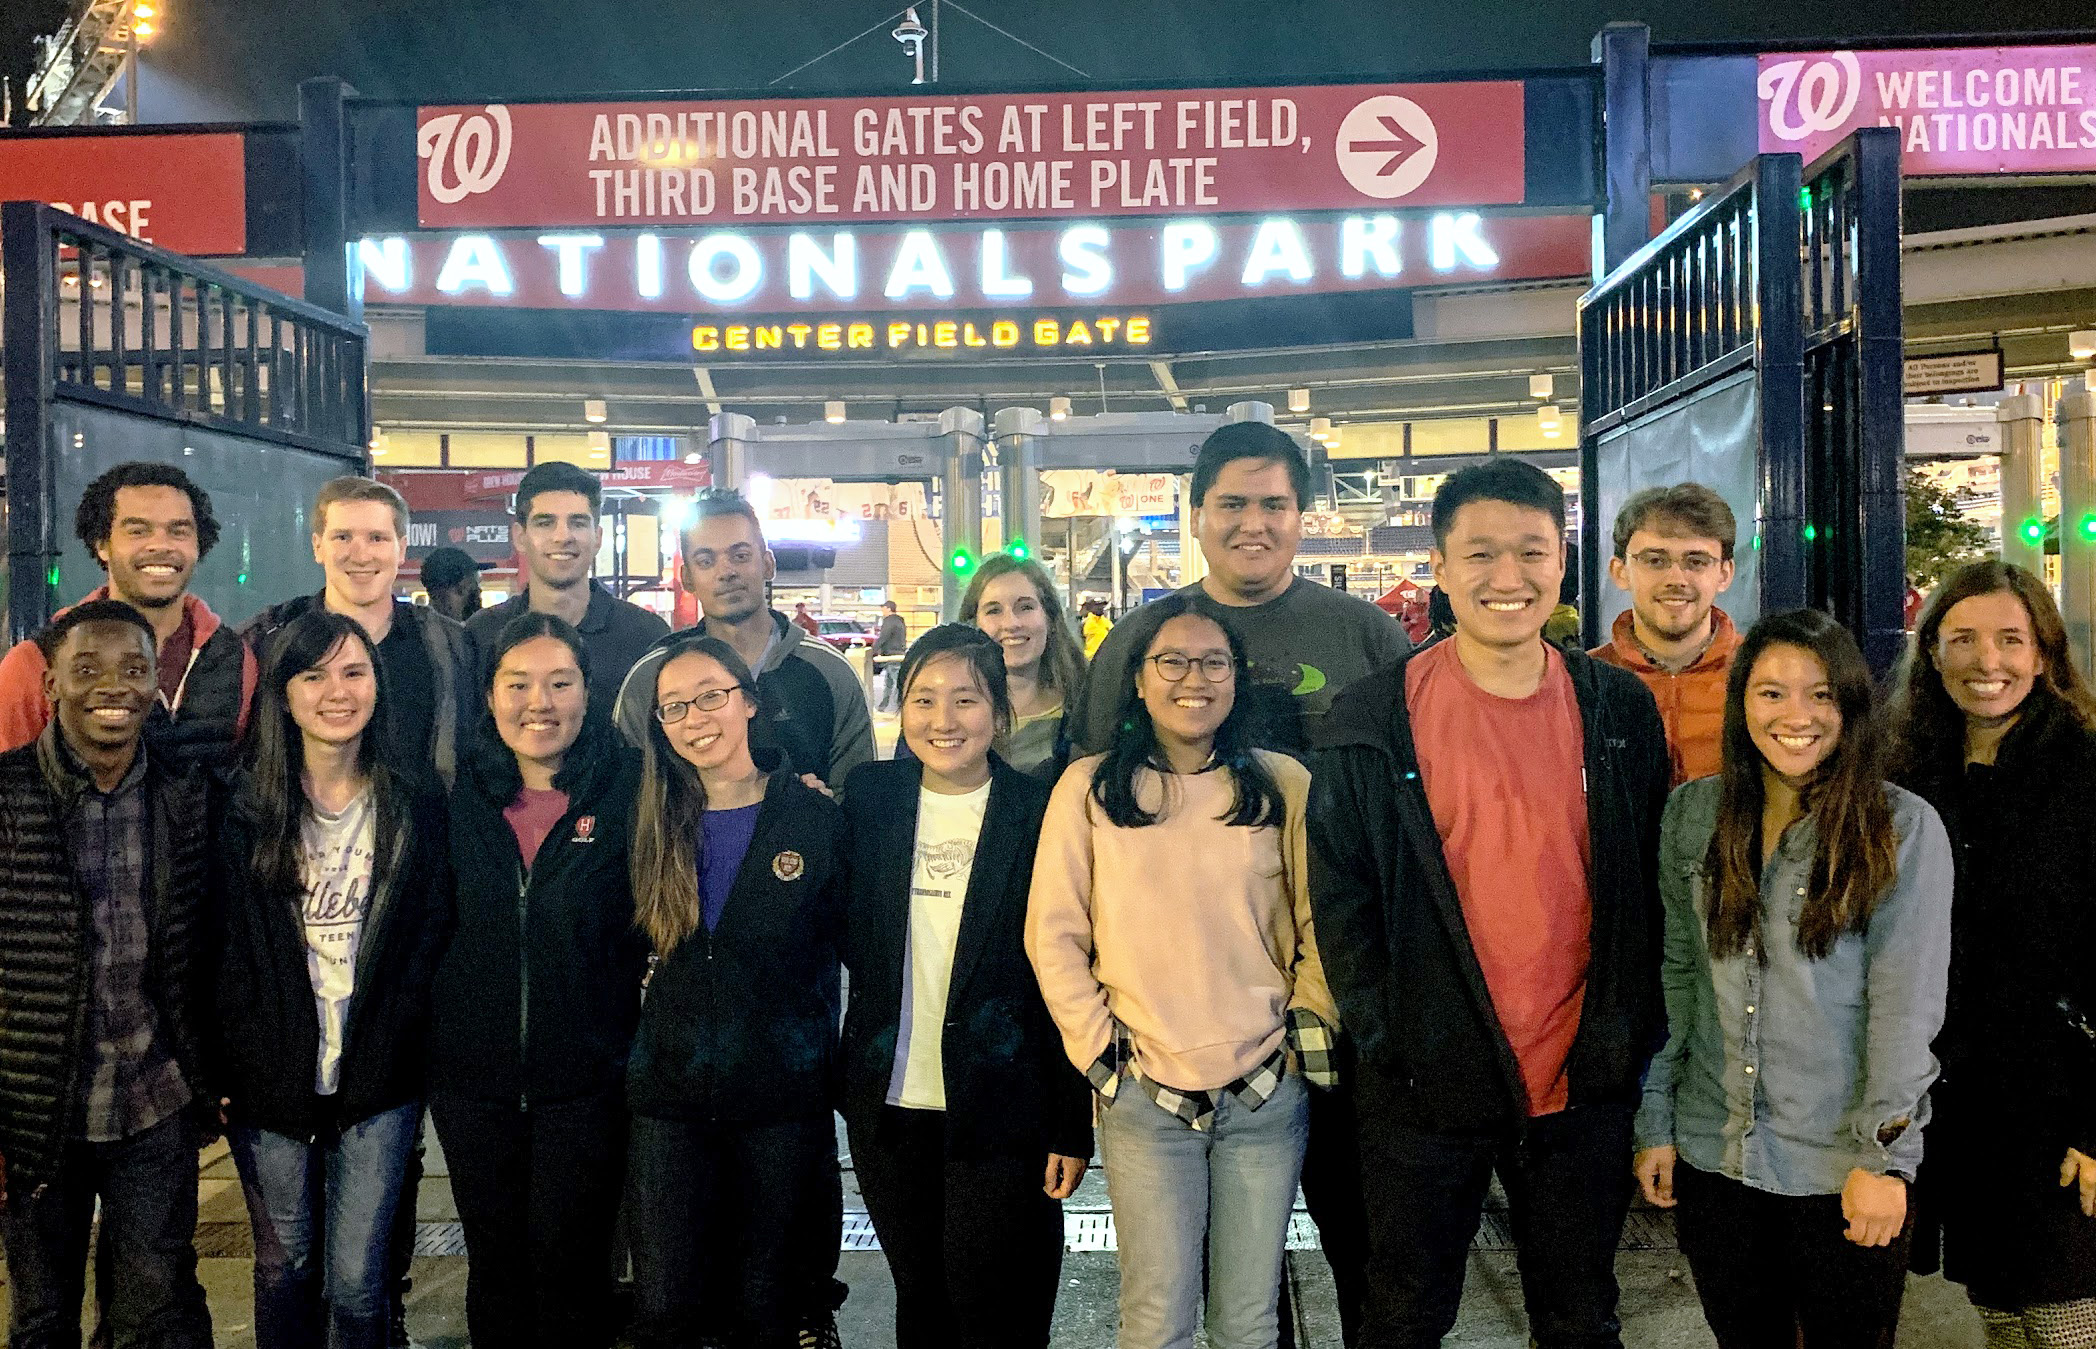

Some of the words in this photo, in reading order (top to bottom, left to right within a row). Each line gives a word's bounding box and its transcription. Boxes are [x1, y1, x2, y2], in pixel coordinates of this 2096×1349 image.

[1876, 67, 2083, 109] WELCOME
[588, 110, 839, 161] ADDITIONAL
[853, 106, 984, 156] GATES
[998, 104, 1048, 153] AT
[1063, 101, 1162, 151] LEFT
[1177, 99, 1312, 154] FIELD,
[588, 168, 716, 217] THIRD
[733, 165, 839, 215] BASE
[853, 163, 936, 212] AND
[954, 160, 1075, 211] HOME
[1091, 158, 1219, 208] PLATE
[358, 226, 1115, 302] NATIONALS
[1161, 213, 1500, 292] PARK
[692, 323, 874, 351] CENTER
[888, 320, 1018, 349] FIELD
[1033, 317, 1151, 346] GATE
[1140, 495, 1164, 503] ONE
[466, 525, 508, 534] NATS
[466, 534, 508, 542] PLUS
[580, 818, 591, 831] H
